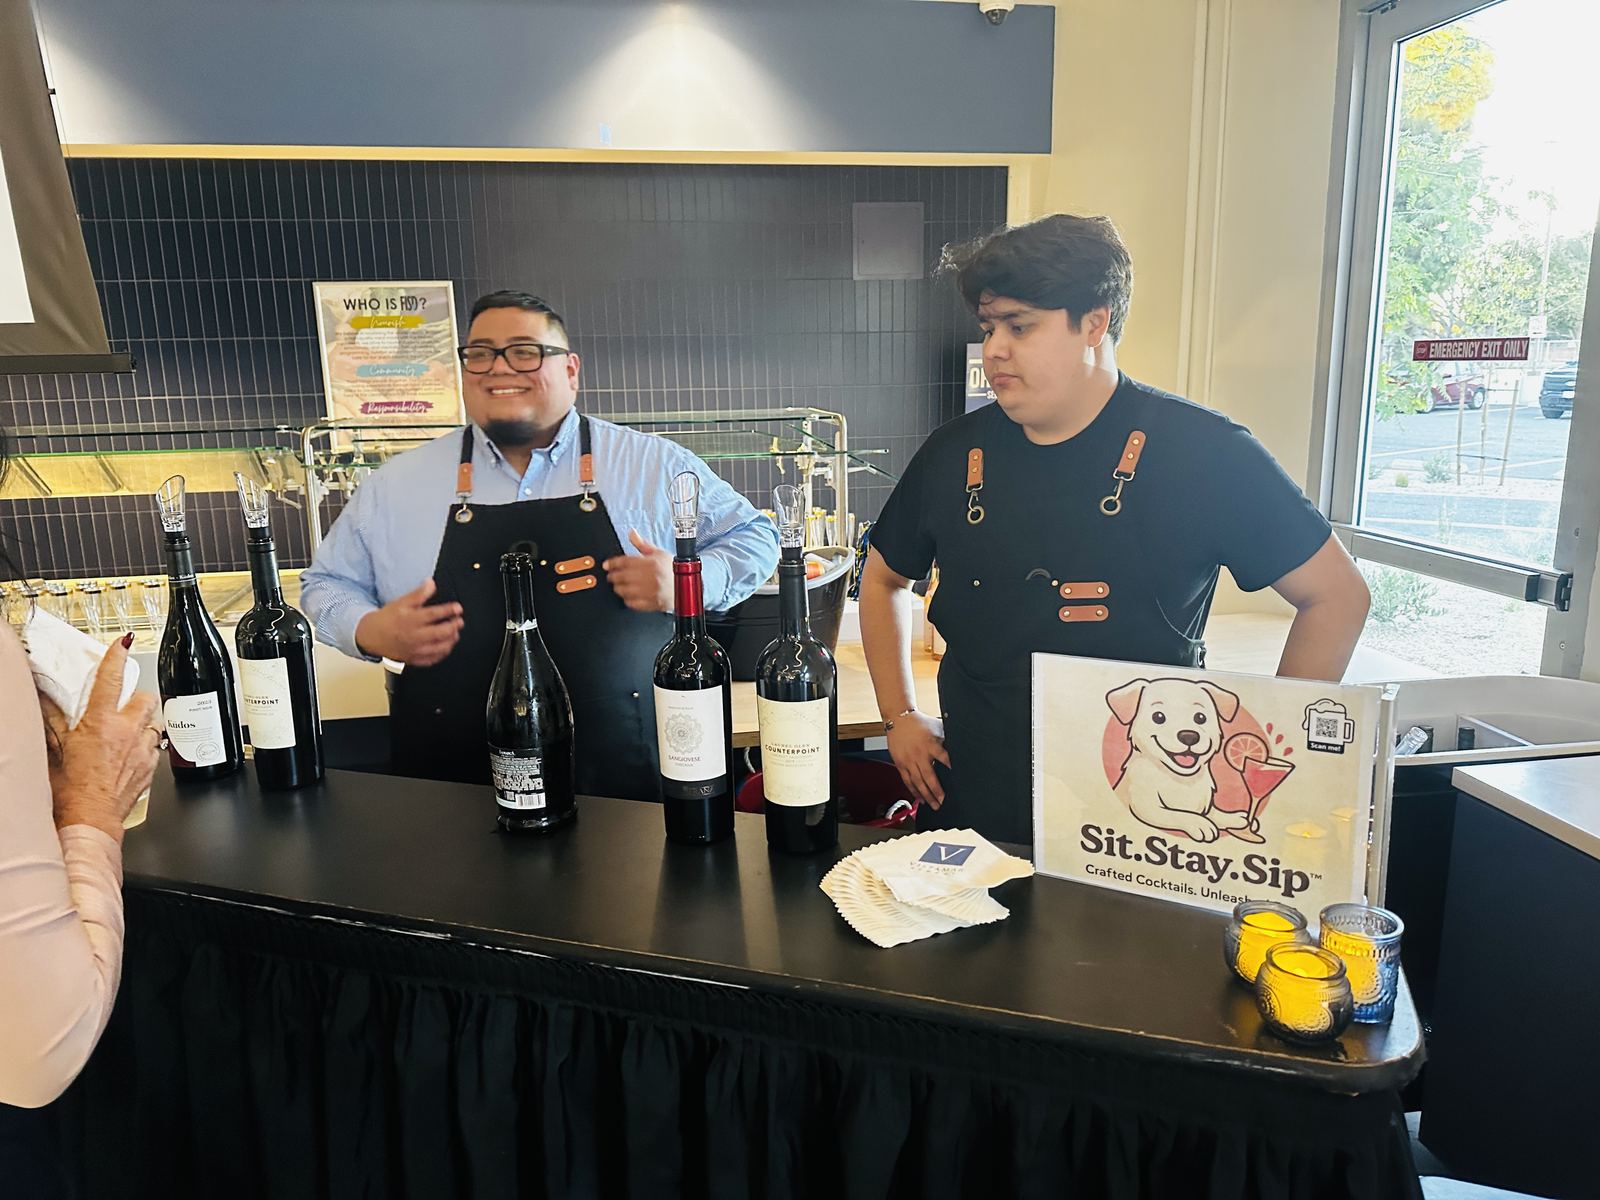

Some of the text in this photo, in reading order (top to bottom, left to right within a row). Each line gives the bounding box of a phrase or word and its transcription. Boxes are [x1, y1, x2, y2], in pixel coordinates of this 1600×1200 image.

[343, 298, 381, 310] WHO
[386, 298, 398, 310] IS
[1429, 340, 1529, 358] EMERGENCY EXIT ONLY
[367, 401, 427, 415] Responsibility
[765, 744, 820, 755] COUNTERPOINT
[937, 845, 968, 861] V
[1085, 864, 1133, 883] Crafted
[1136, 874, 1197, 896] Cocktails.
